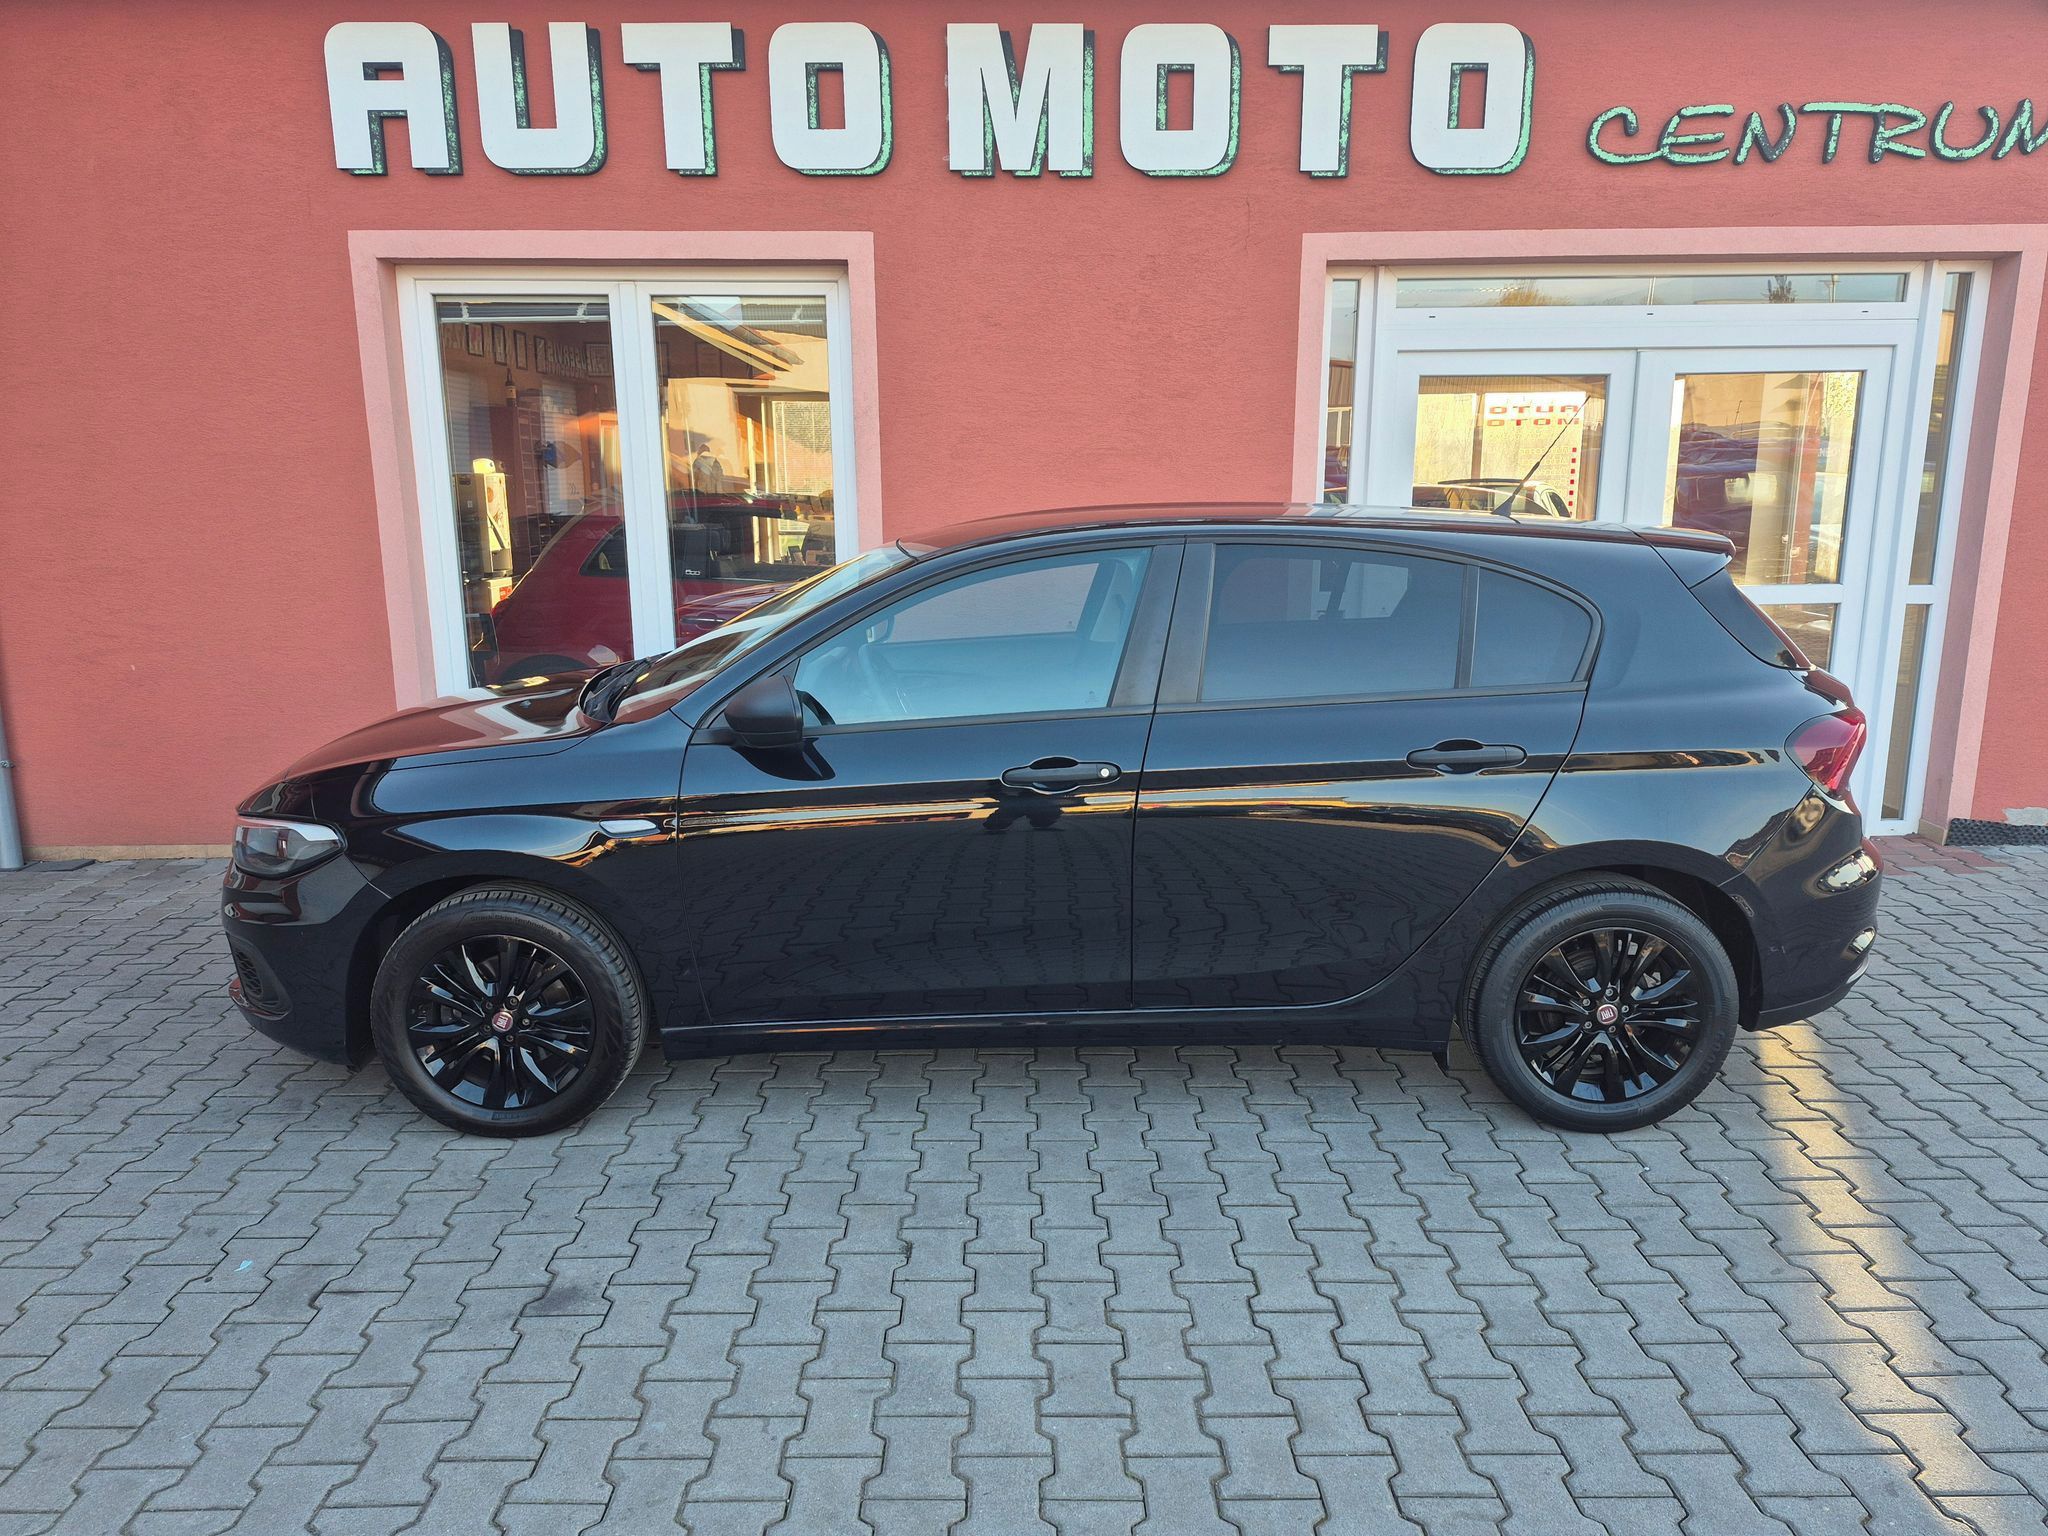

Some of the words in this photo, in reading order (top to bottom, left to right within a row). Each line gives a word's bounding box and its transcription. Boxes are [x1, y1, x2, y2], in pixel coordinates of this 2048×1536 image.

[324, 22, 893, 176] AUTO
[946, 22, 1536, 177] MOTO
[1586, 98, 2048, 165] CENTRUM
